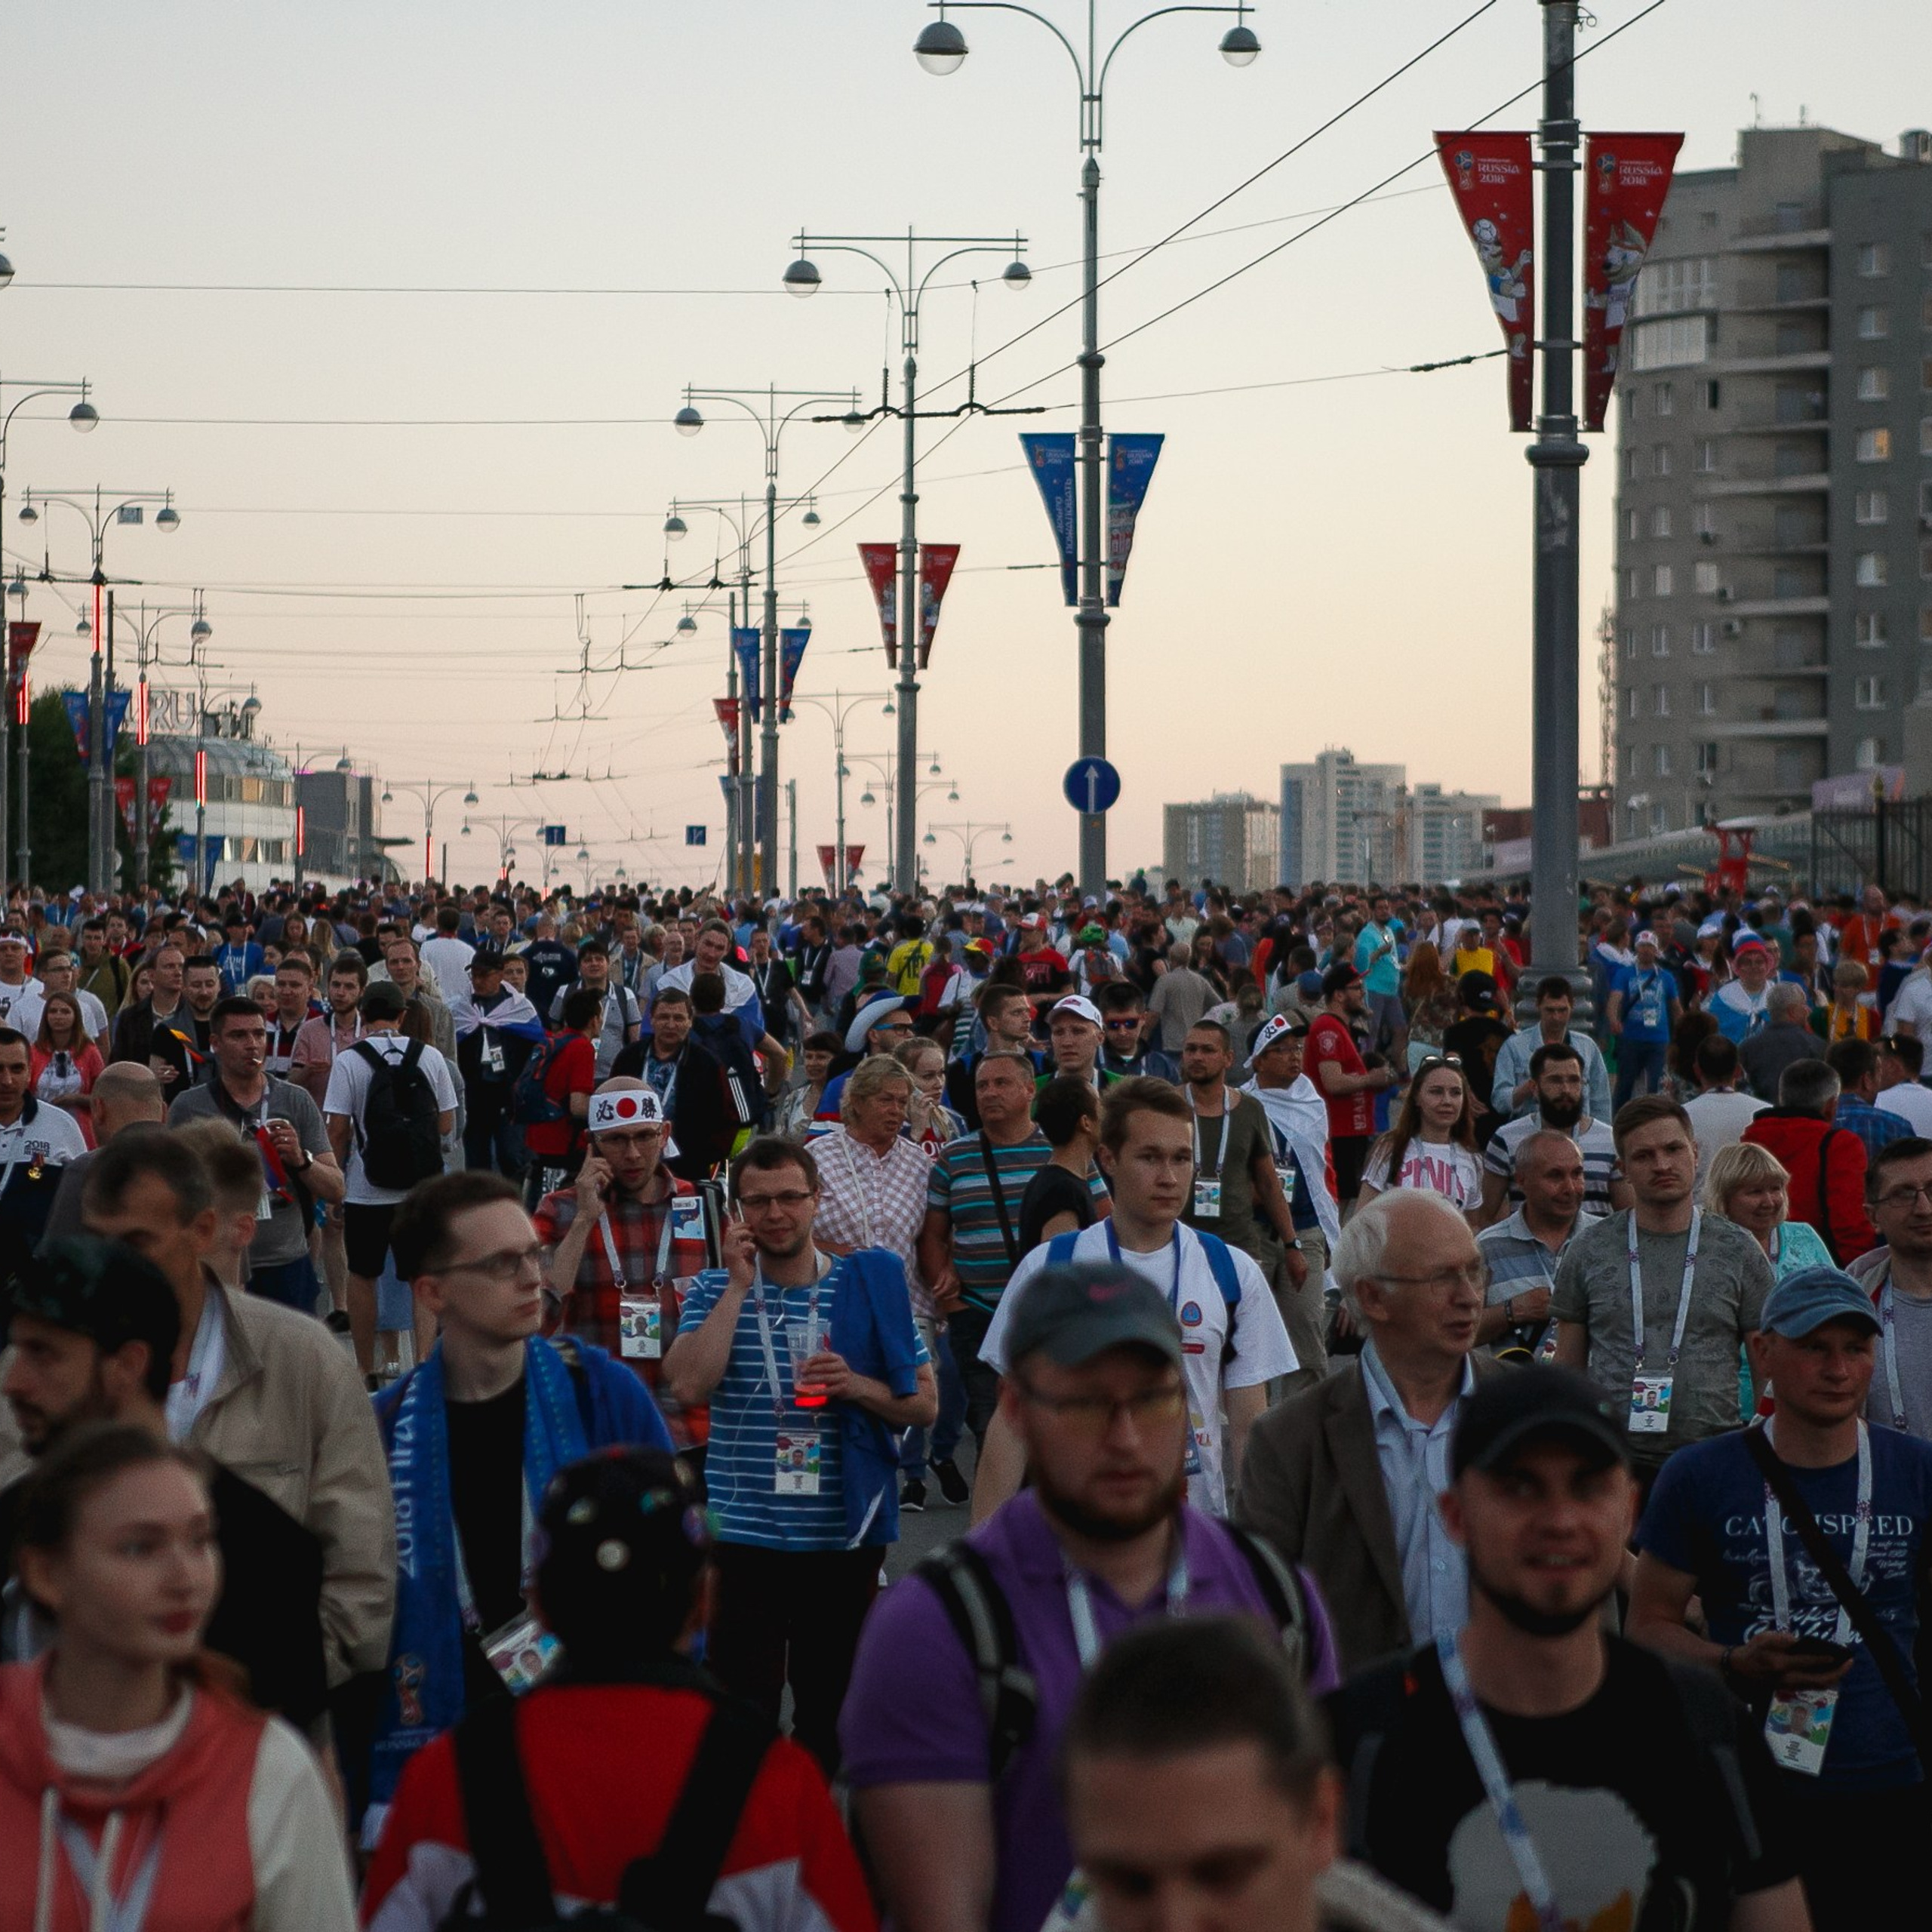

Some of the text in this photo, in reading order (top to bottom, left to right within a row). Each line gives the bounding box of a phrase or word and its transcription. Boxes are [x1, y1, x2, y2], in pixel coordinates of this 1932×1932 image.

[1477, 163, 1521, 174] RUSSIA
[1619, 165, 1663, 177] RUSSIA
[1479, 174, 1506, 184] 2018
[1620, 176, 1648, 186] 2018
[24, 1140, 50, 1150] 2018
[1725, 1514, 1914, 1536] CACSPED
